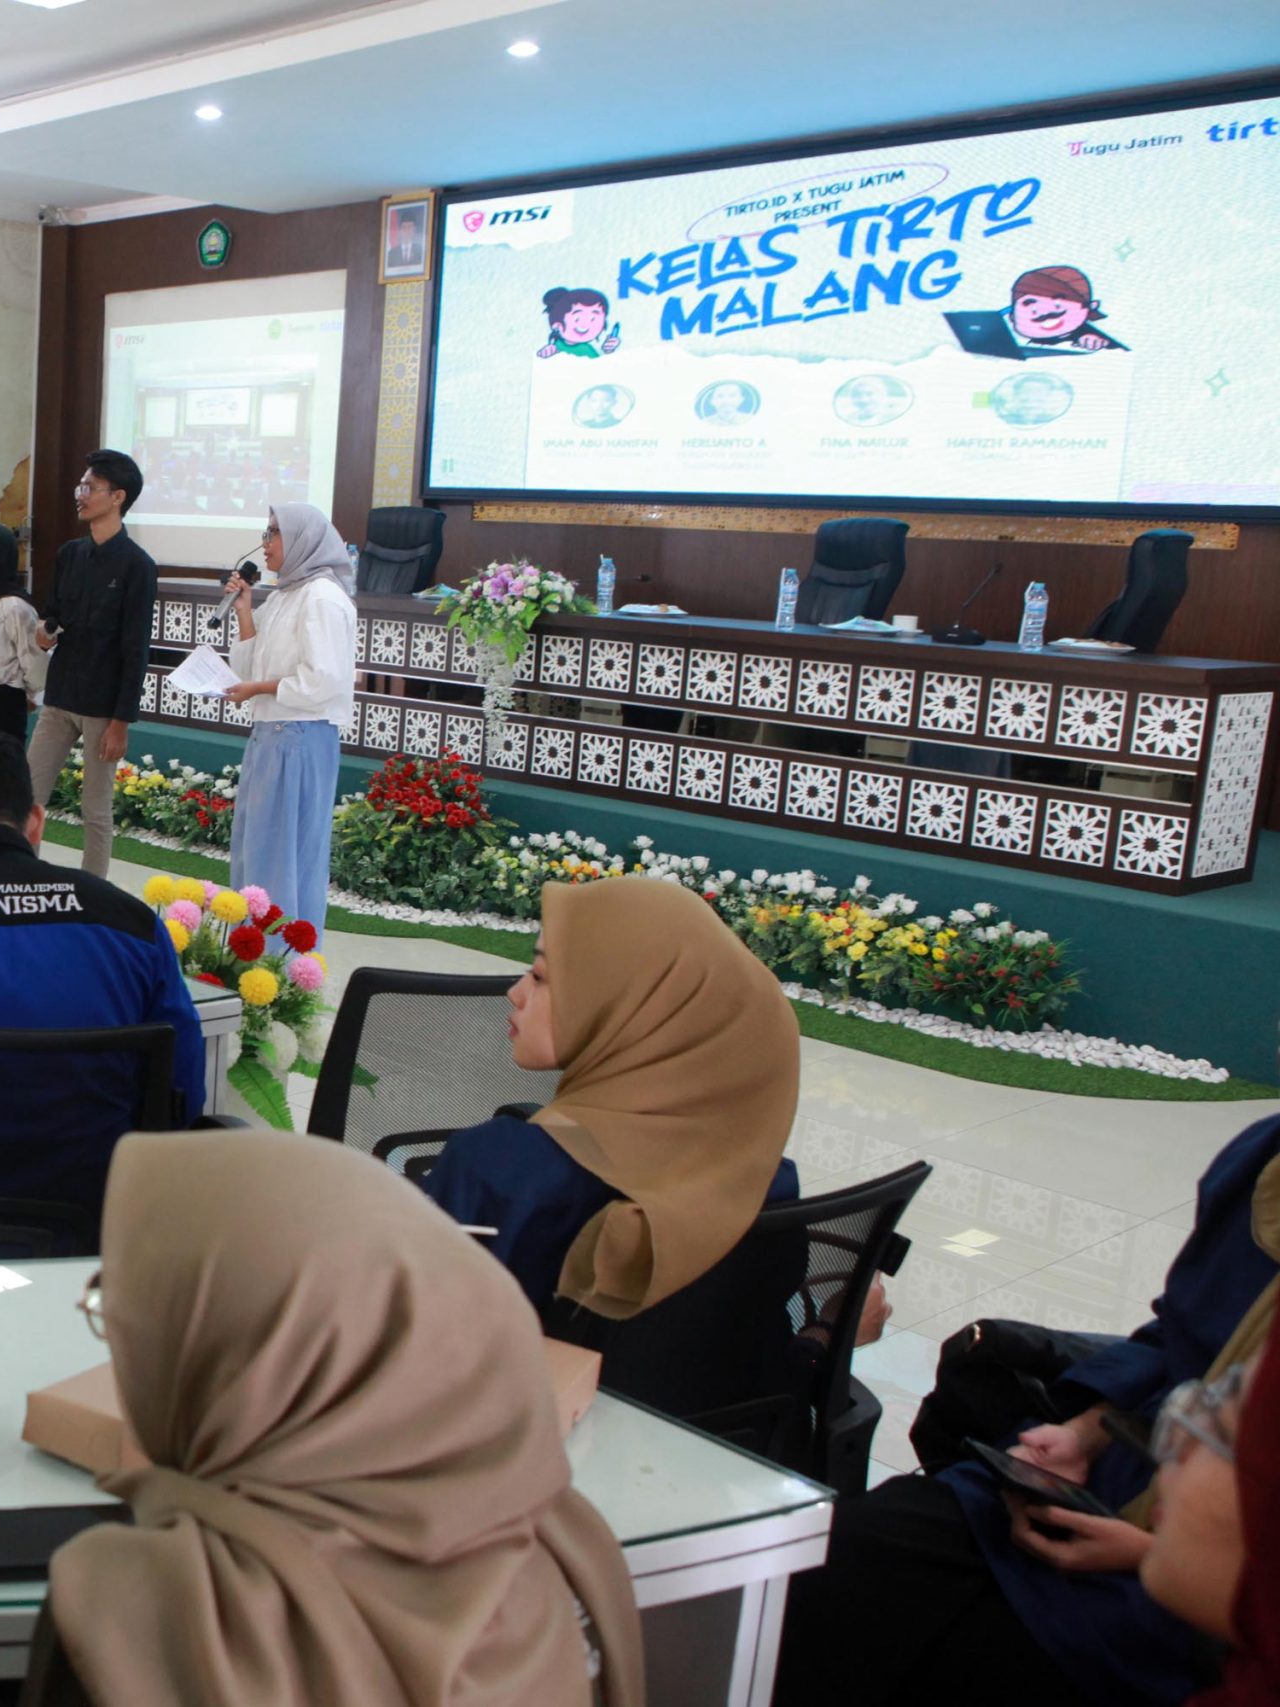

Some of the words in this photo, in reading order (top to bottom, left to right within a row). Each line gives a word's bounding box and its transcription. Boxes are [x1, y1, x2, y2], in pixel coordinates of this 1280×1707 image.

[1205, 117, 1280, 142] tirt
[1067, 140, 1120, 156] Tugu
[1125, 134, 1184, 150] Jatim
[725, 194, 788, 218] TIRTO.ID
[808, 180, 854, 200] TUGU
[857, 169, 907, 191] JATIM
[489, 205, 552, 226] msi
[773, 200, 843, 224] PRESENT
[617, 223, 799, 299] KELAS
[827, 177, 1042, 259] TIRTO
[660, 249, 962, 341] MALANG
[1008, 437, 1108, 449] RAMADHAN
